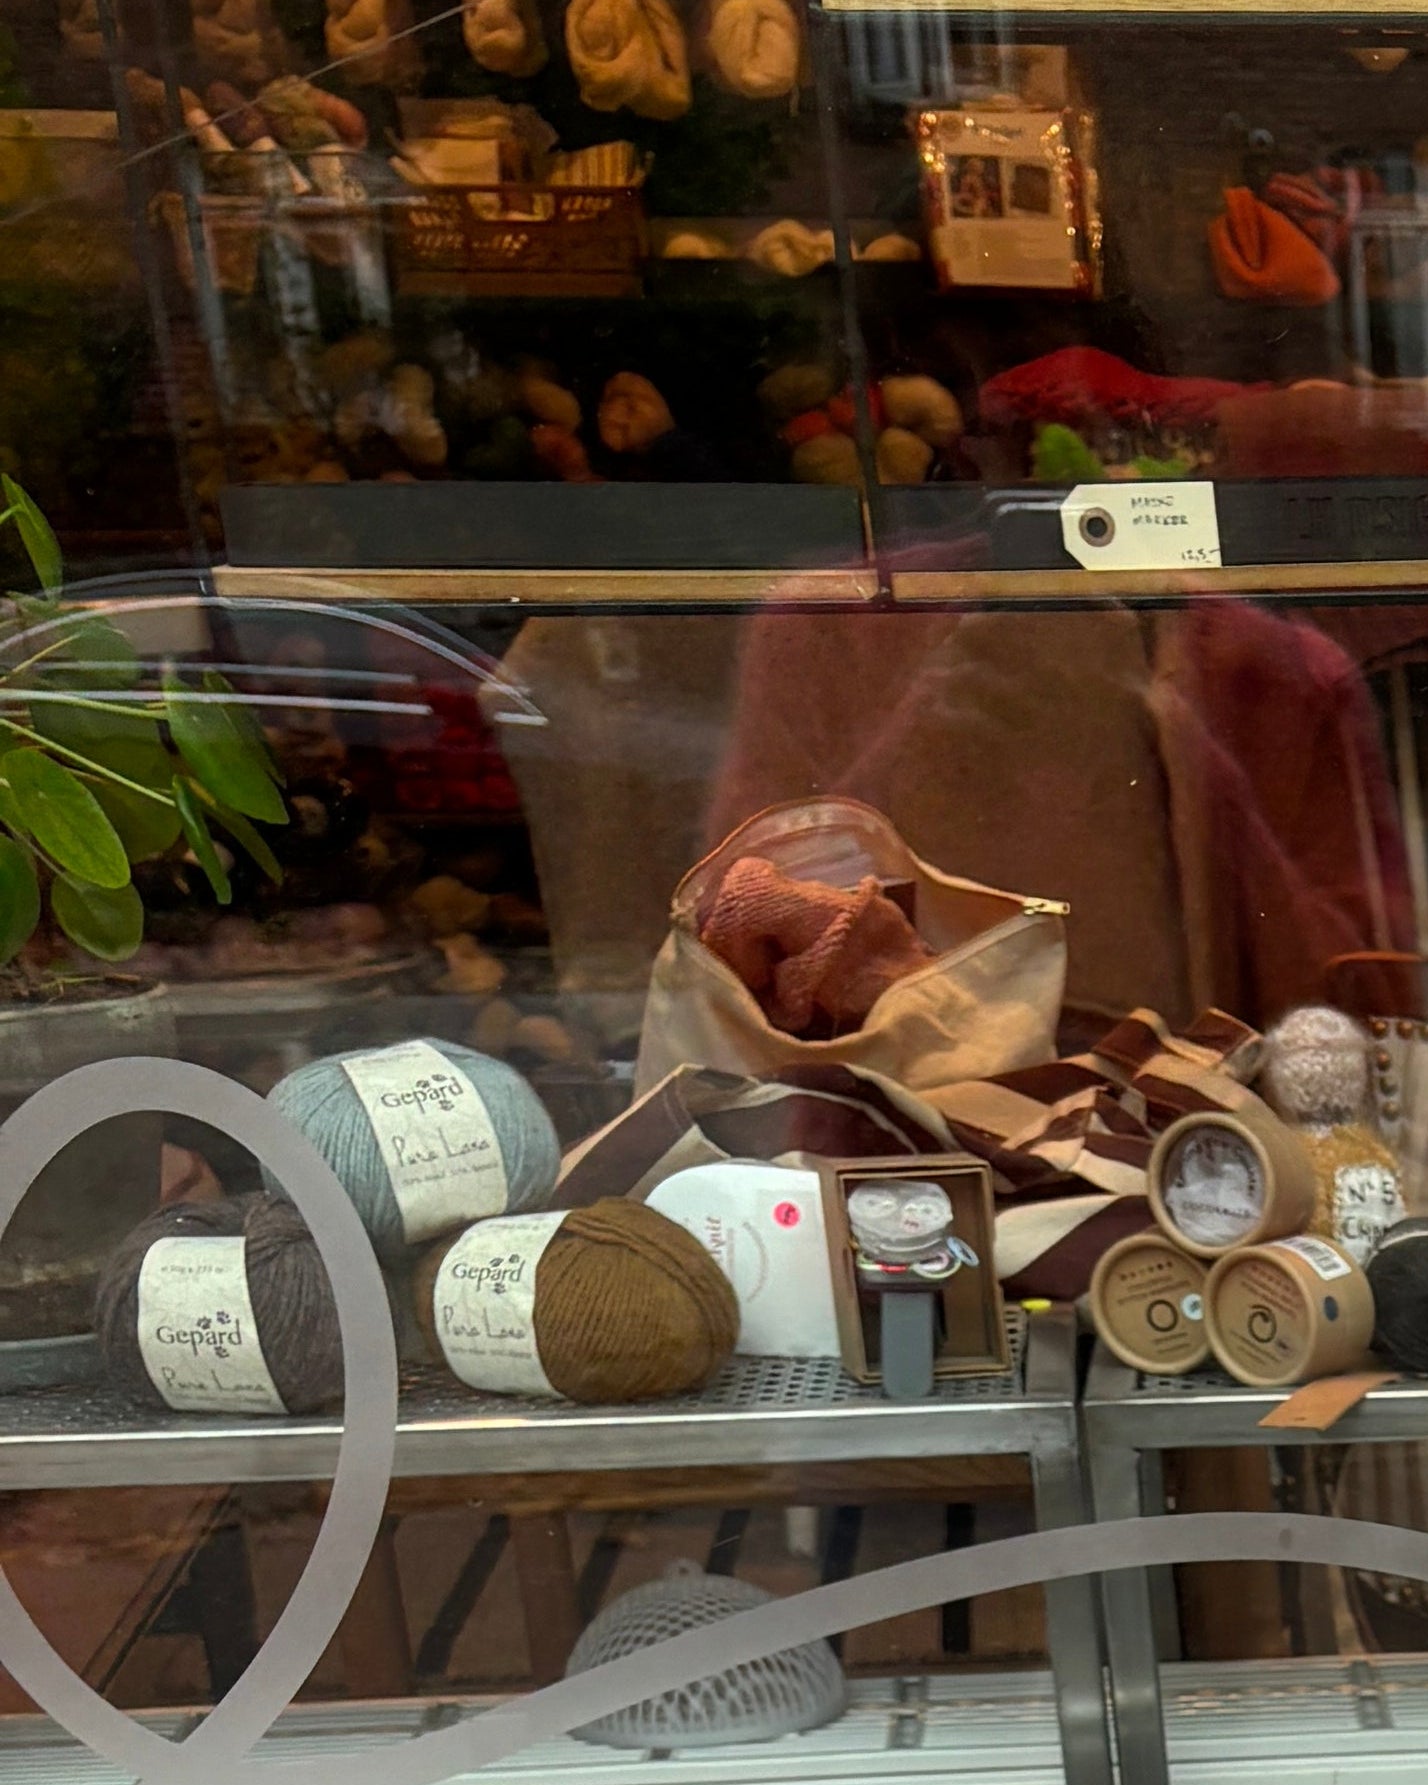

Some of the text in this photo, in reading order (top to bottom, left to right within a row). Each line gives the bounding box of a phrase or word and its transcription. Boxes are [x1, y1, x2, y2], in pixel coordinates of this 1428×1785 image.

[381, 1076, 464, 1114] Gepard
[452, 1259, 526, 1292] Gepard
[156, 1318, 242, 1357] Gepard
